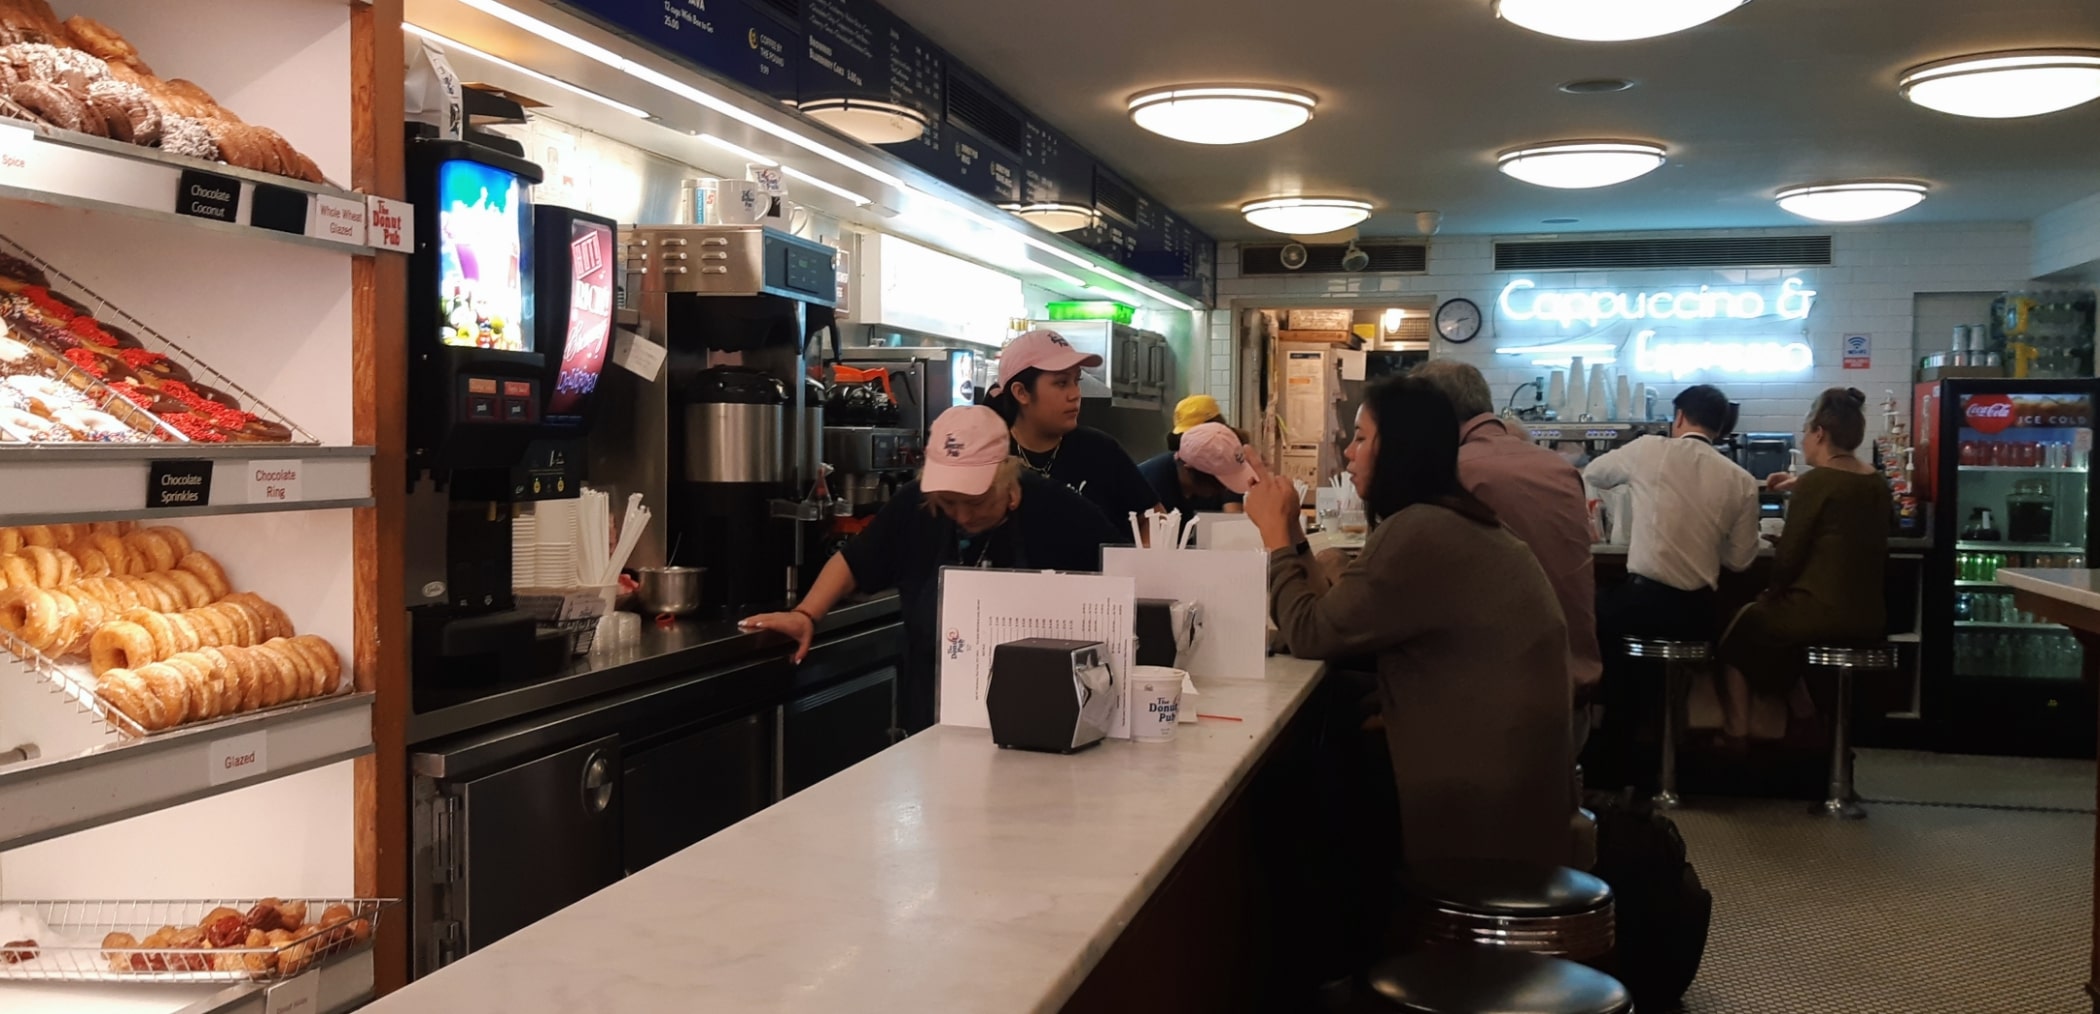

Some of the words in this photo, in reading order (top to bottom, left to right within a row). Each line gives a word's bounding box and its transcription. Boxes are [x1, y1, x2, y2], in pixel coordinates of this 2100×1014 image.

[2, 154, 25, 168] Spice
[191, 184, 231, 202] Chocolate
[191, 201, 225, 217] Coconut
[320, 204, 341, 218] Whole
[342, 208, 363, 223] Wheat
[377, 200, 389, 215] The
[373, 210, 402, 230] Donut
[329, 222, 353, 237] Glazed
[384, 228, 400, 246] Pub
[1499, 278, 1765, 328] Cappuccino
[1776, 277, 1817, 320] &
[2018, 415, 2042, 425] ICE
[2049, 415, 2088, 425] COLD
[161, 474, 203, 486] Chocolate
[255, 469, 297, 482] Chocolate
[160, 490, 199, 504] Sprinkles
[266, 486, 286, 500] Ring
[1149, 703, 1178, 713] Donut
[1157, 697, 1170, 705] The
[1159, 713, 1176, 722] Pub
[224, 750, 256, 769] Glazed
